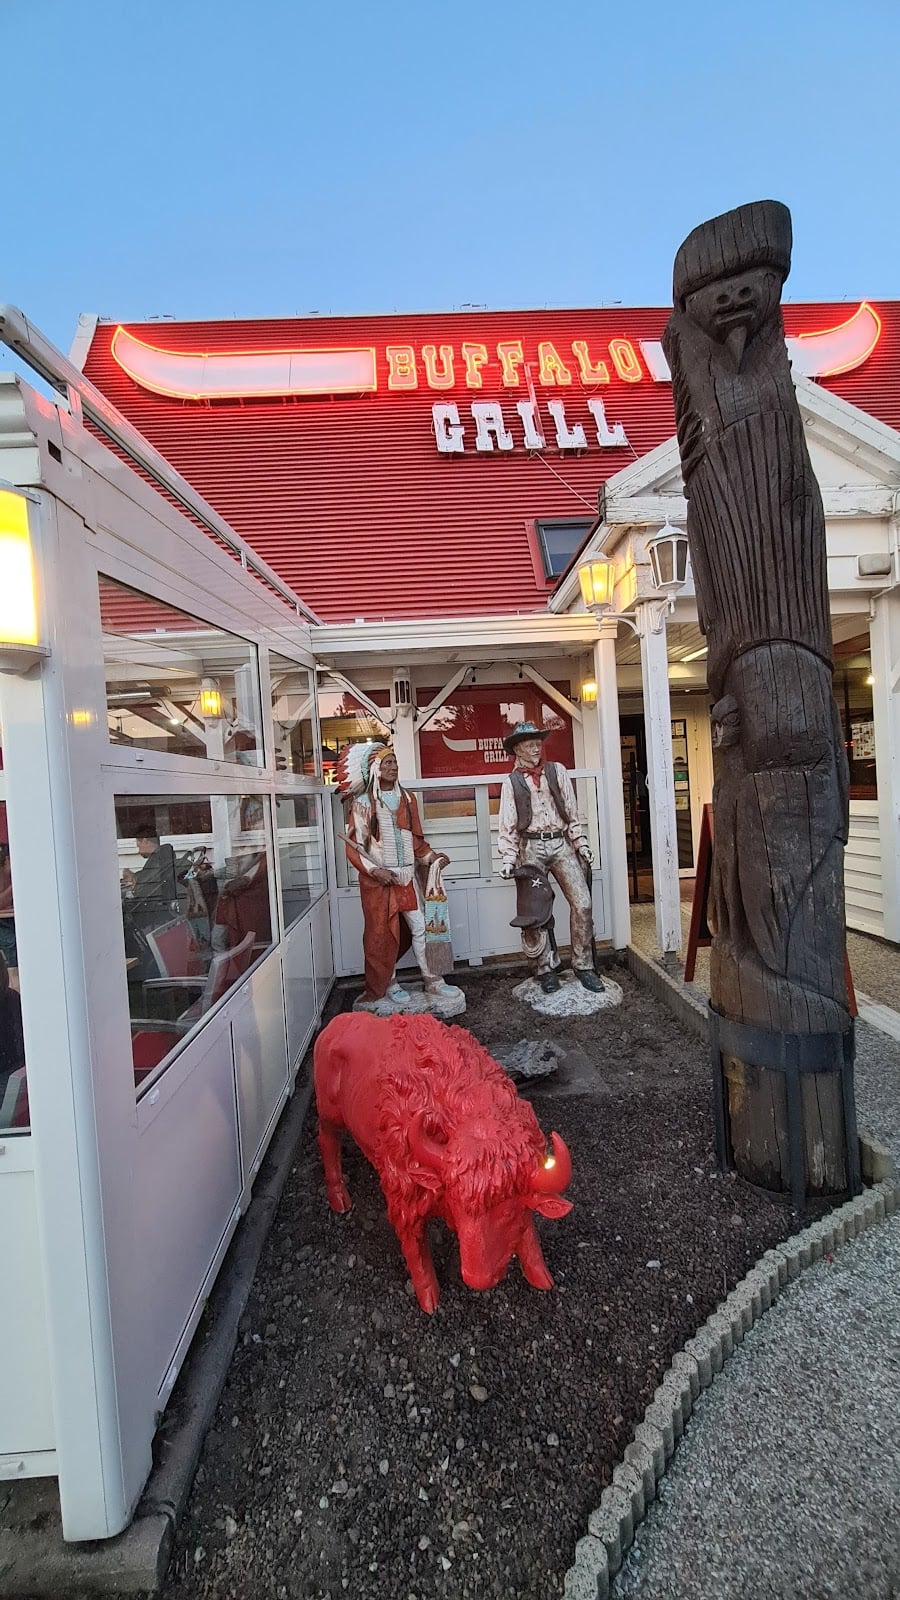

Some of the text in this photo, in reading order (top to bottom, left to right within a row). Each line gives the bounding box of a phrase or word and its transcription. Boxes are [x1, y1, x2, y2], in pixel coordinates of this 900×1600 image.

[386, 339, 642, 390] BUFFALO
[432, 398, 628, 452] GRILL
[478, 737, 506, 750] BUFFA
[484, 750, 509, 763] GRILL
